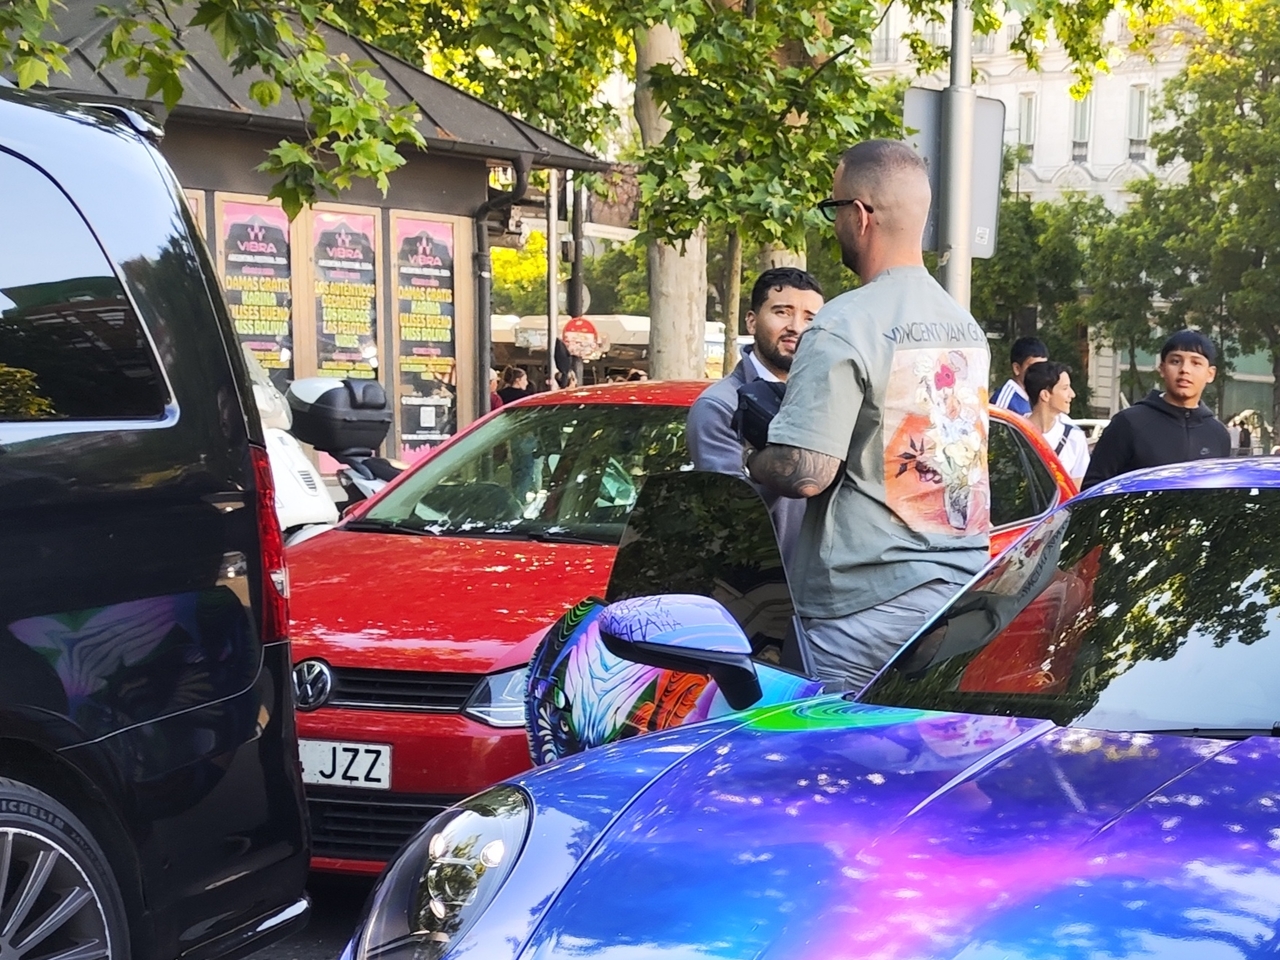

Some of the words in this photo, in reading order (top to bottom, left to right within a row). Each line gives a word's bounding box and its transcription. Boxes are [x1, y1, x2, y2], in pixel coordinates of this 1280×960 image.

[237, 240, 277, 254] VIBRA
[326, 246, 363, 260] VIBRA
[408, 253, 442, 266] VIBRA
[226, 275, 259, 290] DAMAS
[260, 277, 289, 292] GRATIS
[398, 286, 425, 300] DAMAS
[426, 287, 452, 303] GRATIS
[882, 322, 941, 344] VINCENT
[941, 322, 967, 342] VAN
[318, 746, 382, 783] JZZ
[0, 800, 65, 829] ICHELIN
